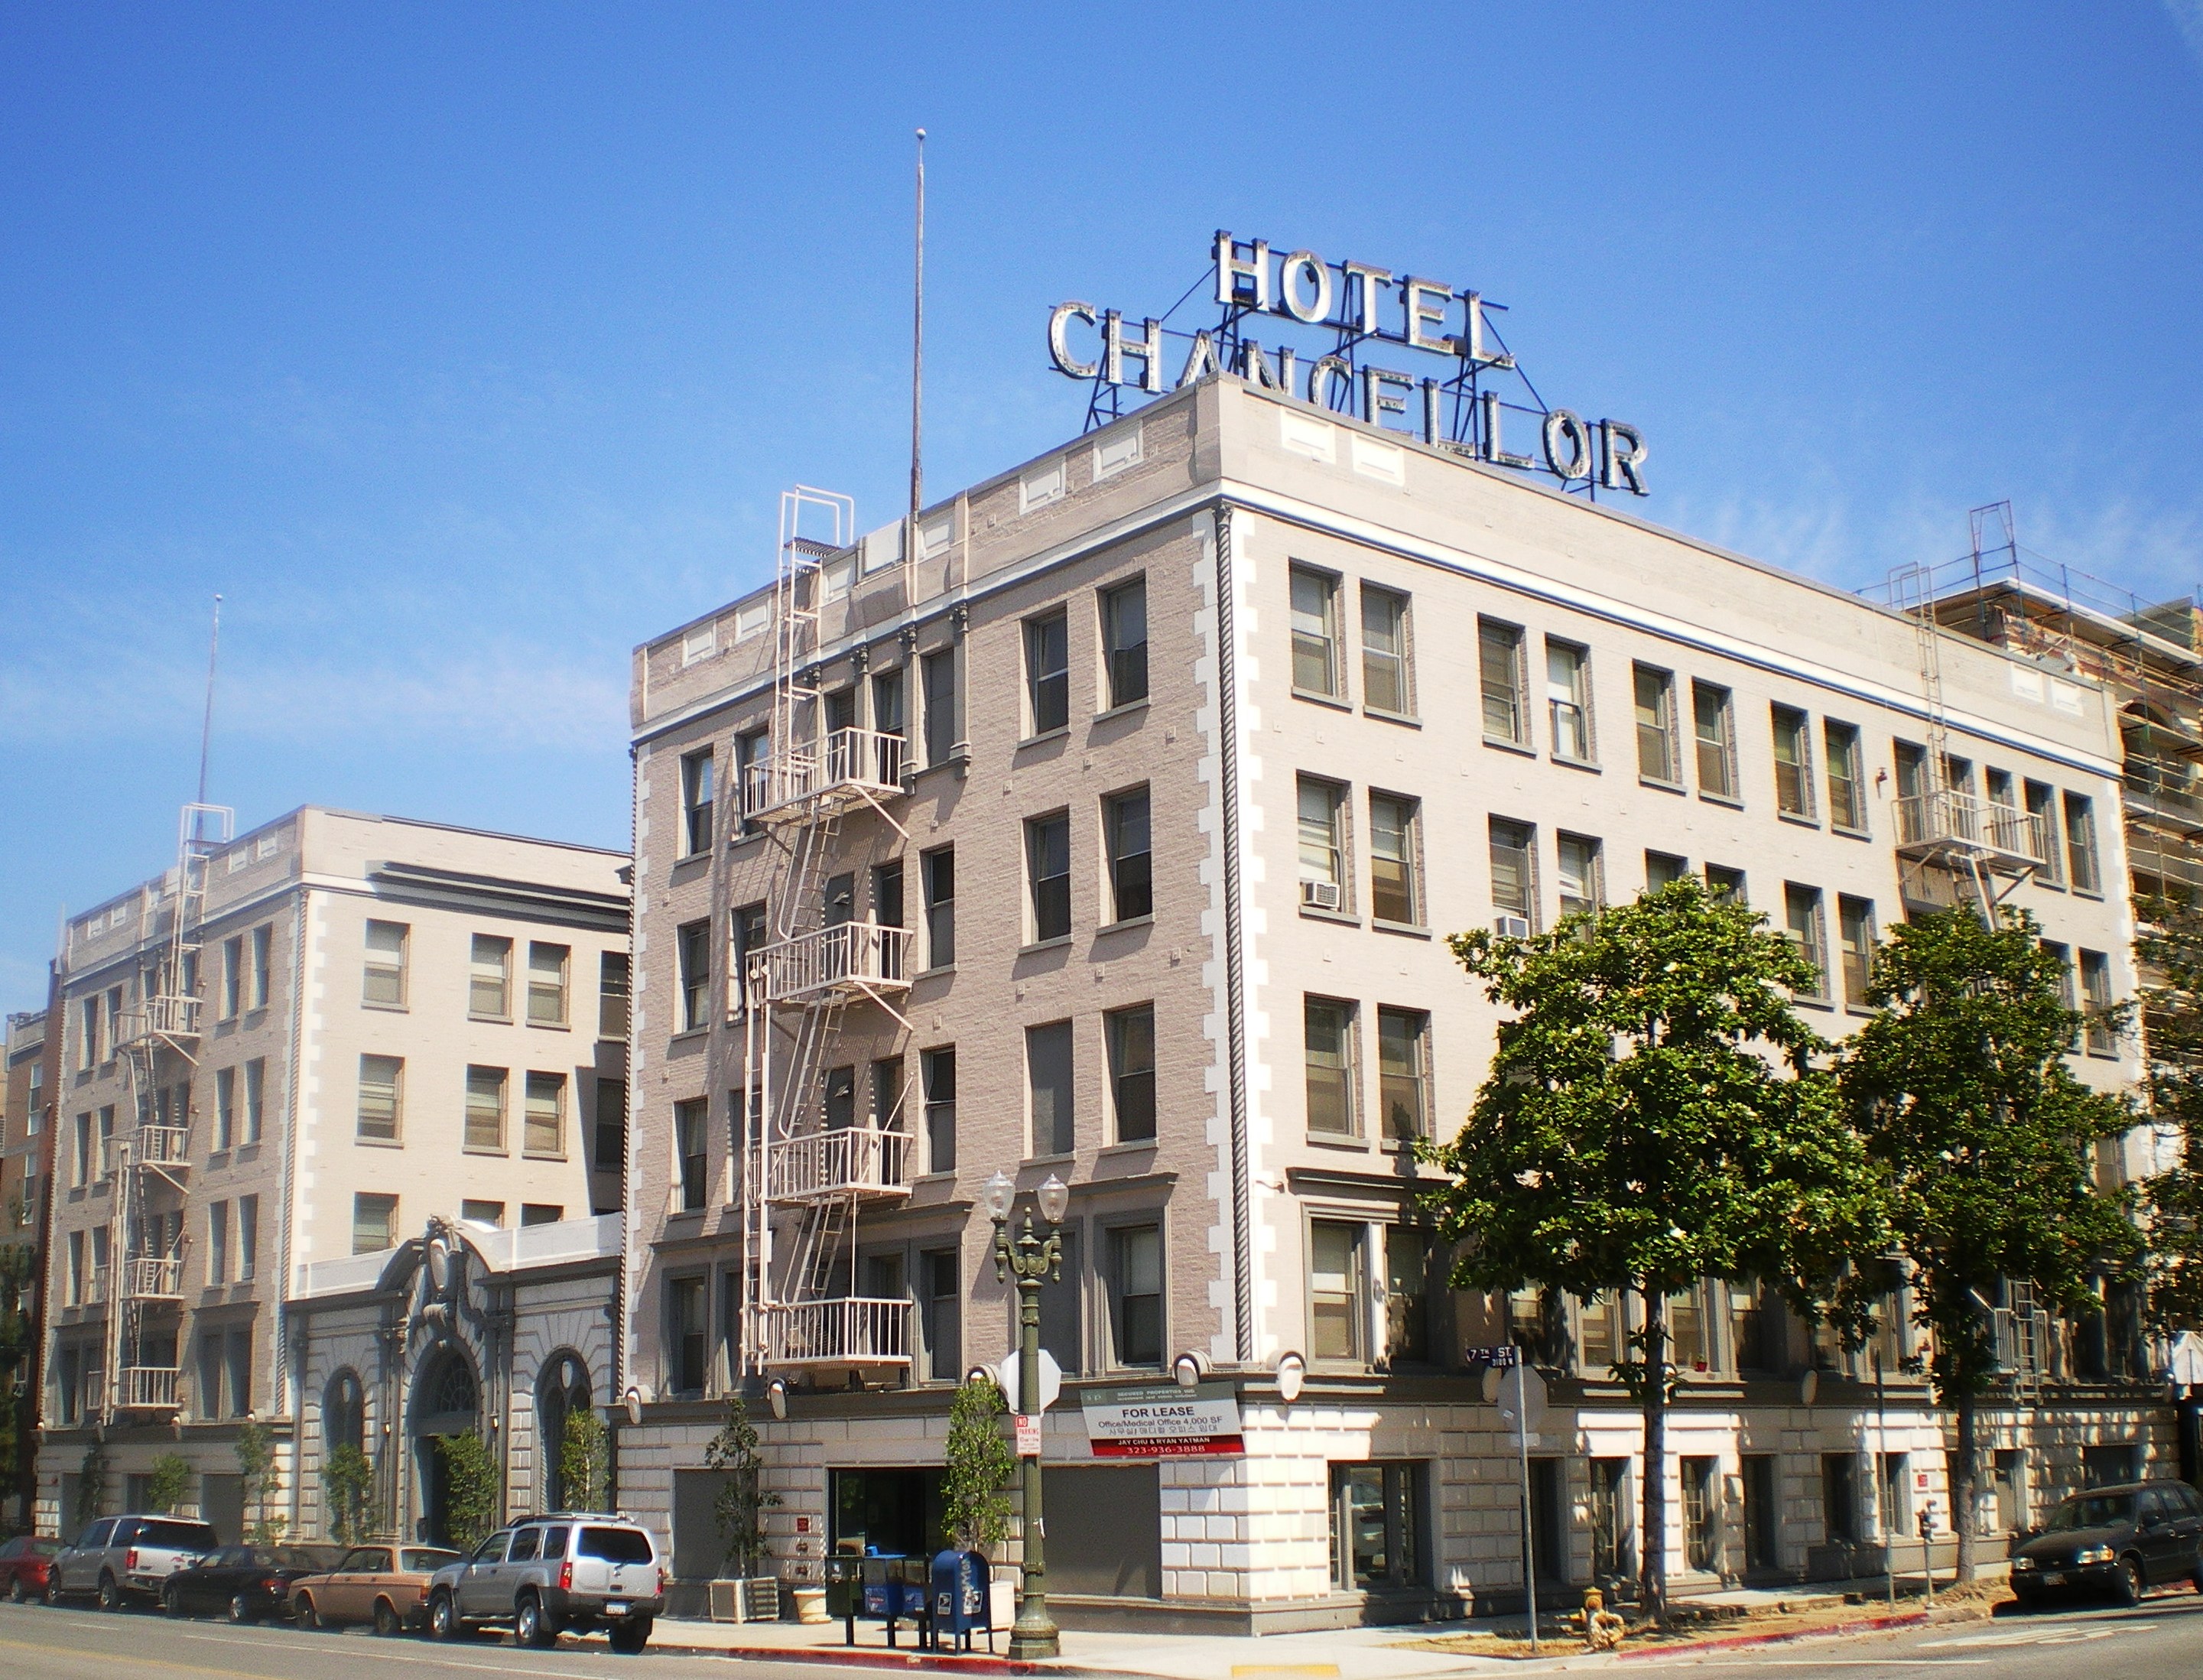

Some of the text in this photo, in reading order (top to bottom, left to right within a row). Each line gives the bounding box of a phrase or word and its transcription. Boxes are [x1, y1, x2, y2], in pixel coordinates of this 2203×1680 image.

[1212, 229, 1516, 370] HOTEL
[1048, 301, 1650, 496] CHANCELLOR
[1122, 1406, 1194, 1418] FOR LEASE
[1018, 1417, 1027, 1427] NO
[1098, 1418, 1155, 1428] Office/Medical
[1157, 1418, 1181, 1426] Office
[1184, 1417, 1207, 1425] 4,000
[1126, 1444, 1206, 1454] 323-936-3888
